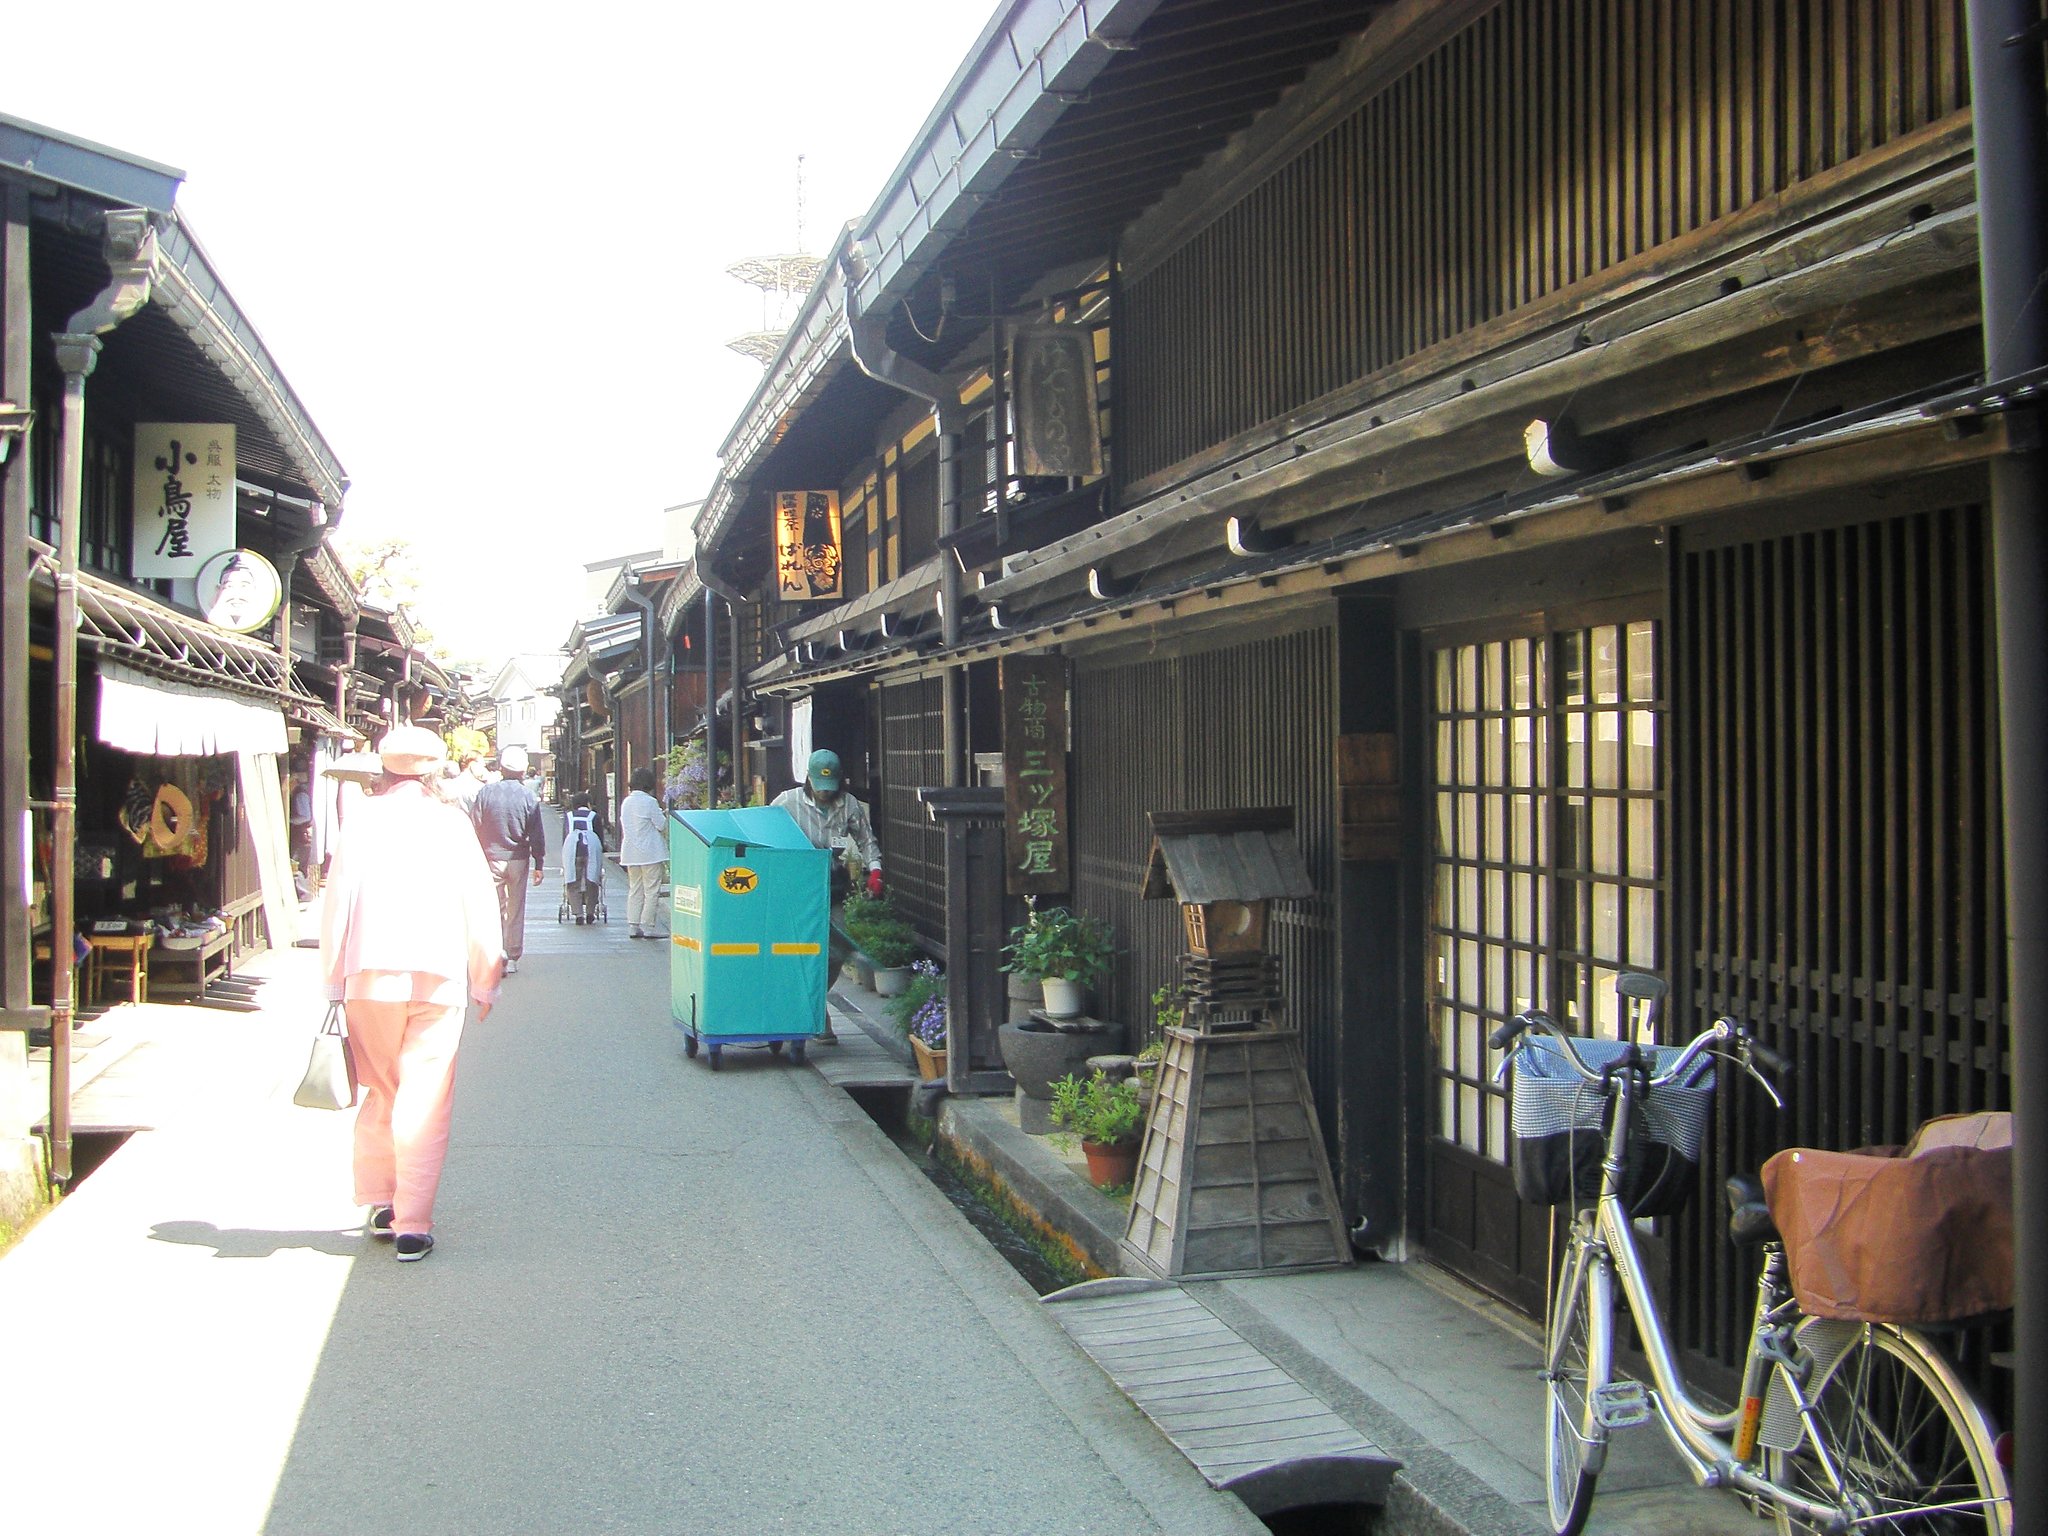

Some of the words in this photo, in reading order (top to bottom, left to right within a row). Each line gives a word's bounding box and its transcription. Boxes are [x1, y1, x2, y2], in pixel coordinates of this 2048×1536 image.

[154, 440, 197, 559] 小鳥屋
[1018, 674, 1048, 740] 古物商
[1017, 750, 1060, 874] 三ツ塚屋
